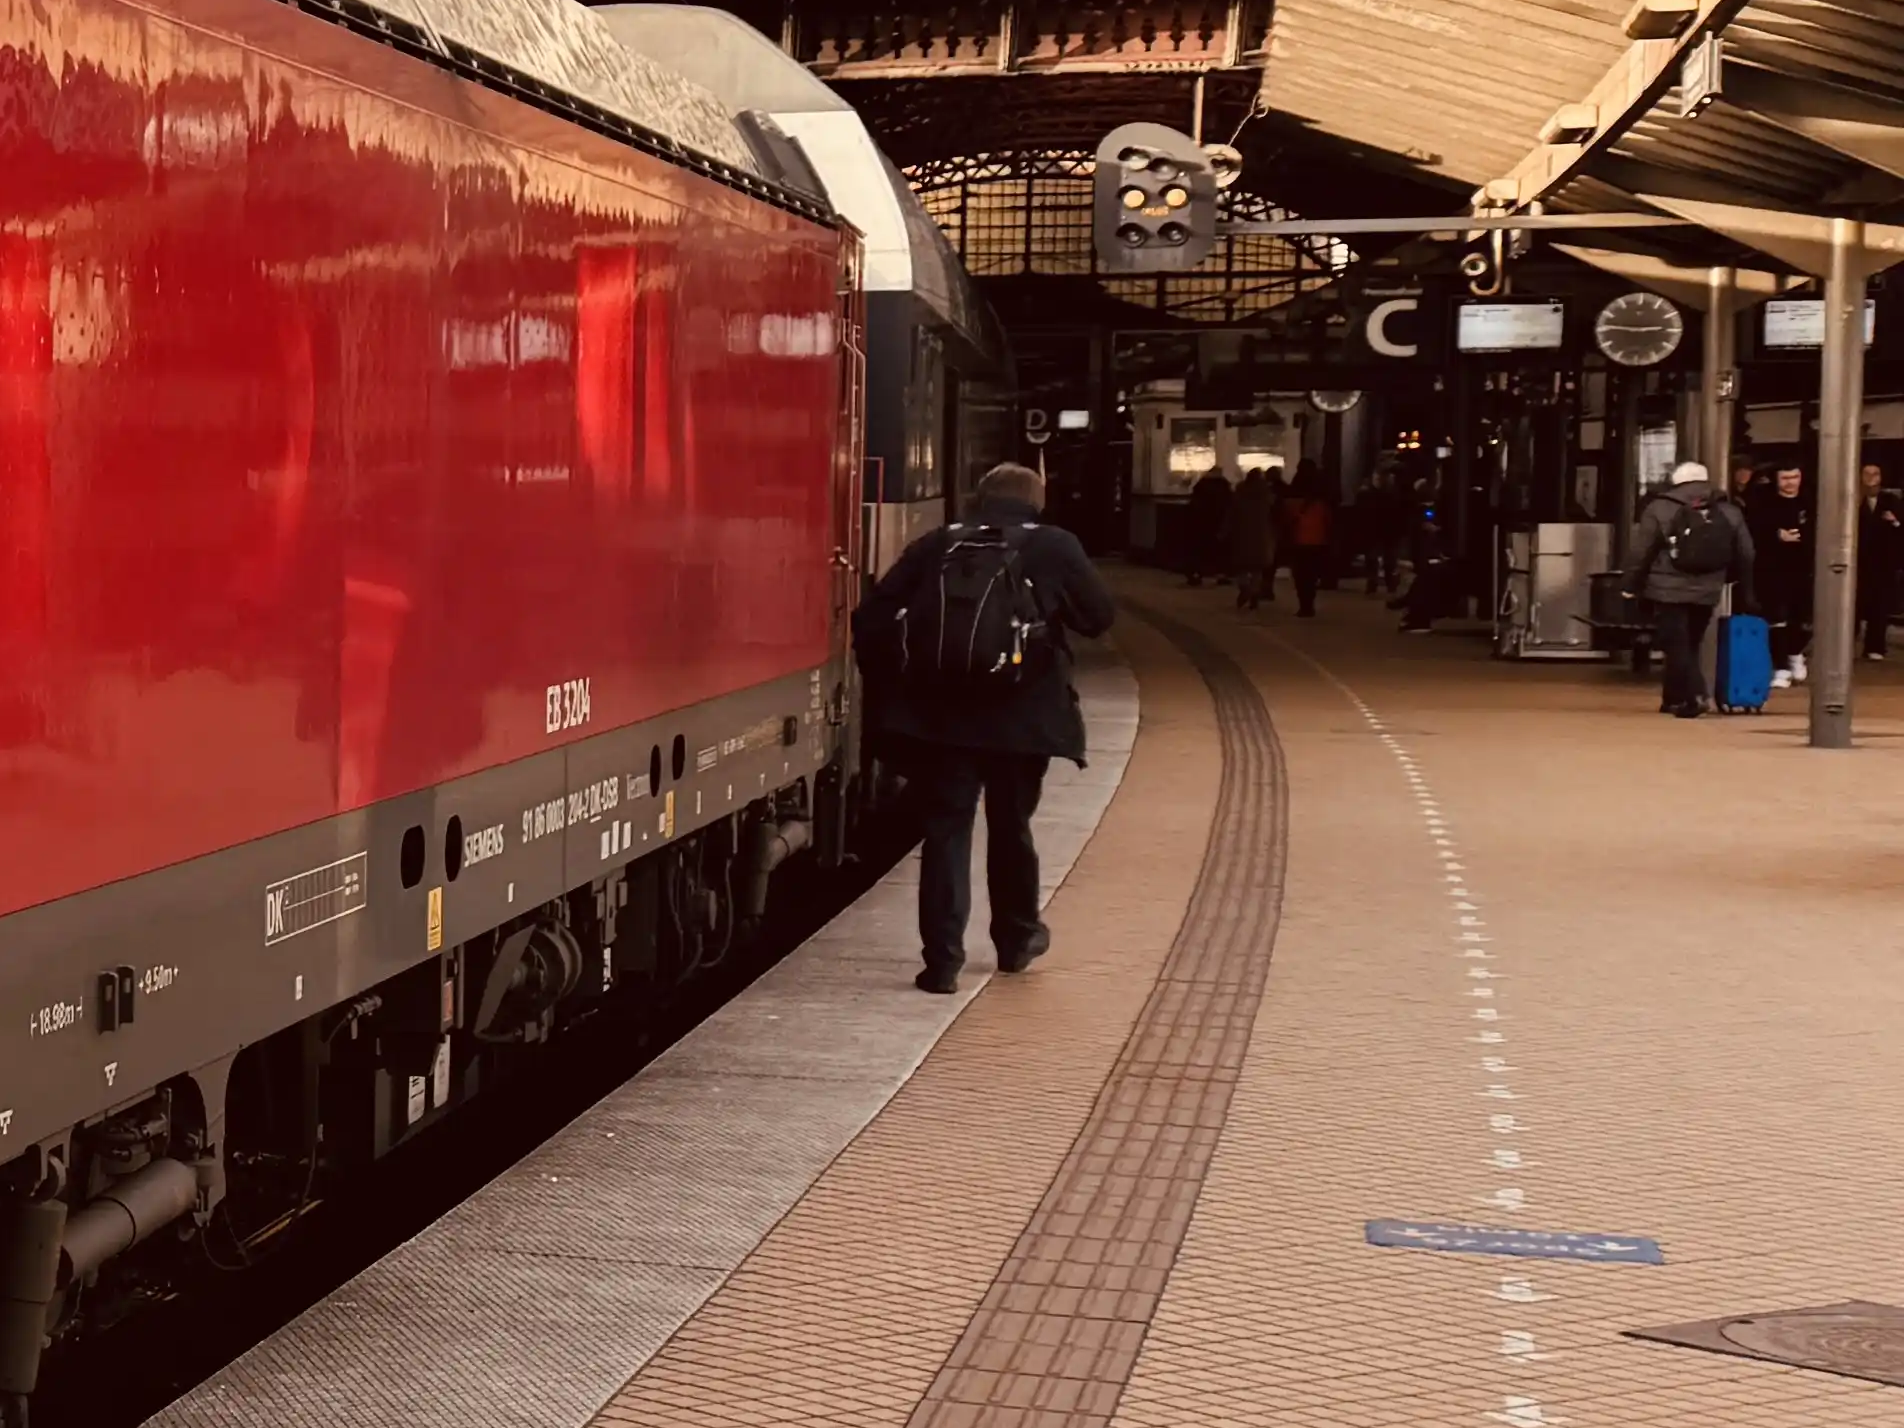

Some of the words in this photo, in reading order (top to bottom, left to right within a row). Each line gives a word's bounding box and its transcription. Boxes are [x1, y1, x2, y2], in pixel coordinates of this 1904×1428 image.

[1366, 299, 1417, 357] C
[1026, 408, 1047, 430] D
[563, 676, 590, 729] 3204
[464, 824, 504, 867] SIEMENS
[267, 889, 284, 937] DK
